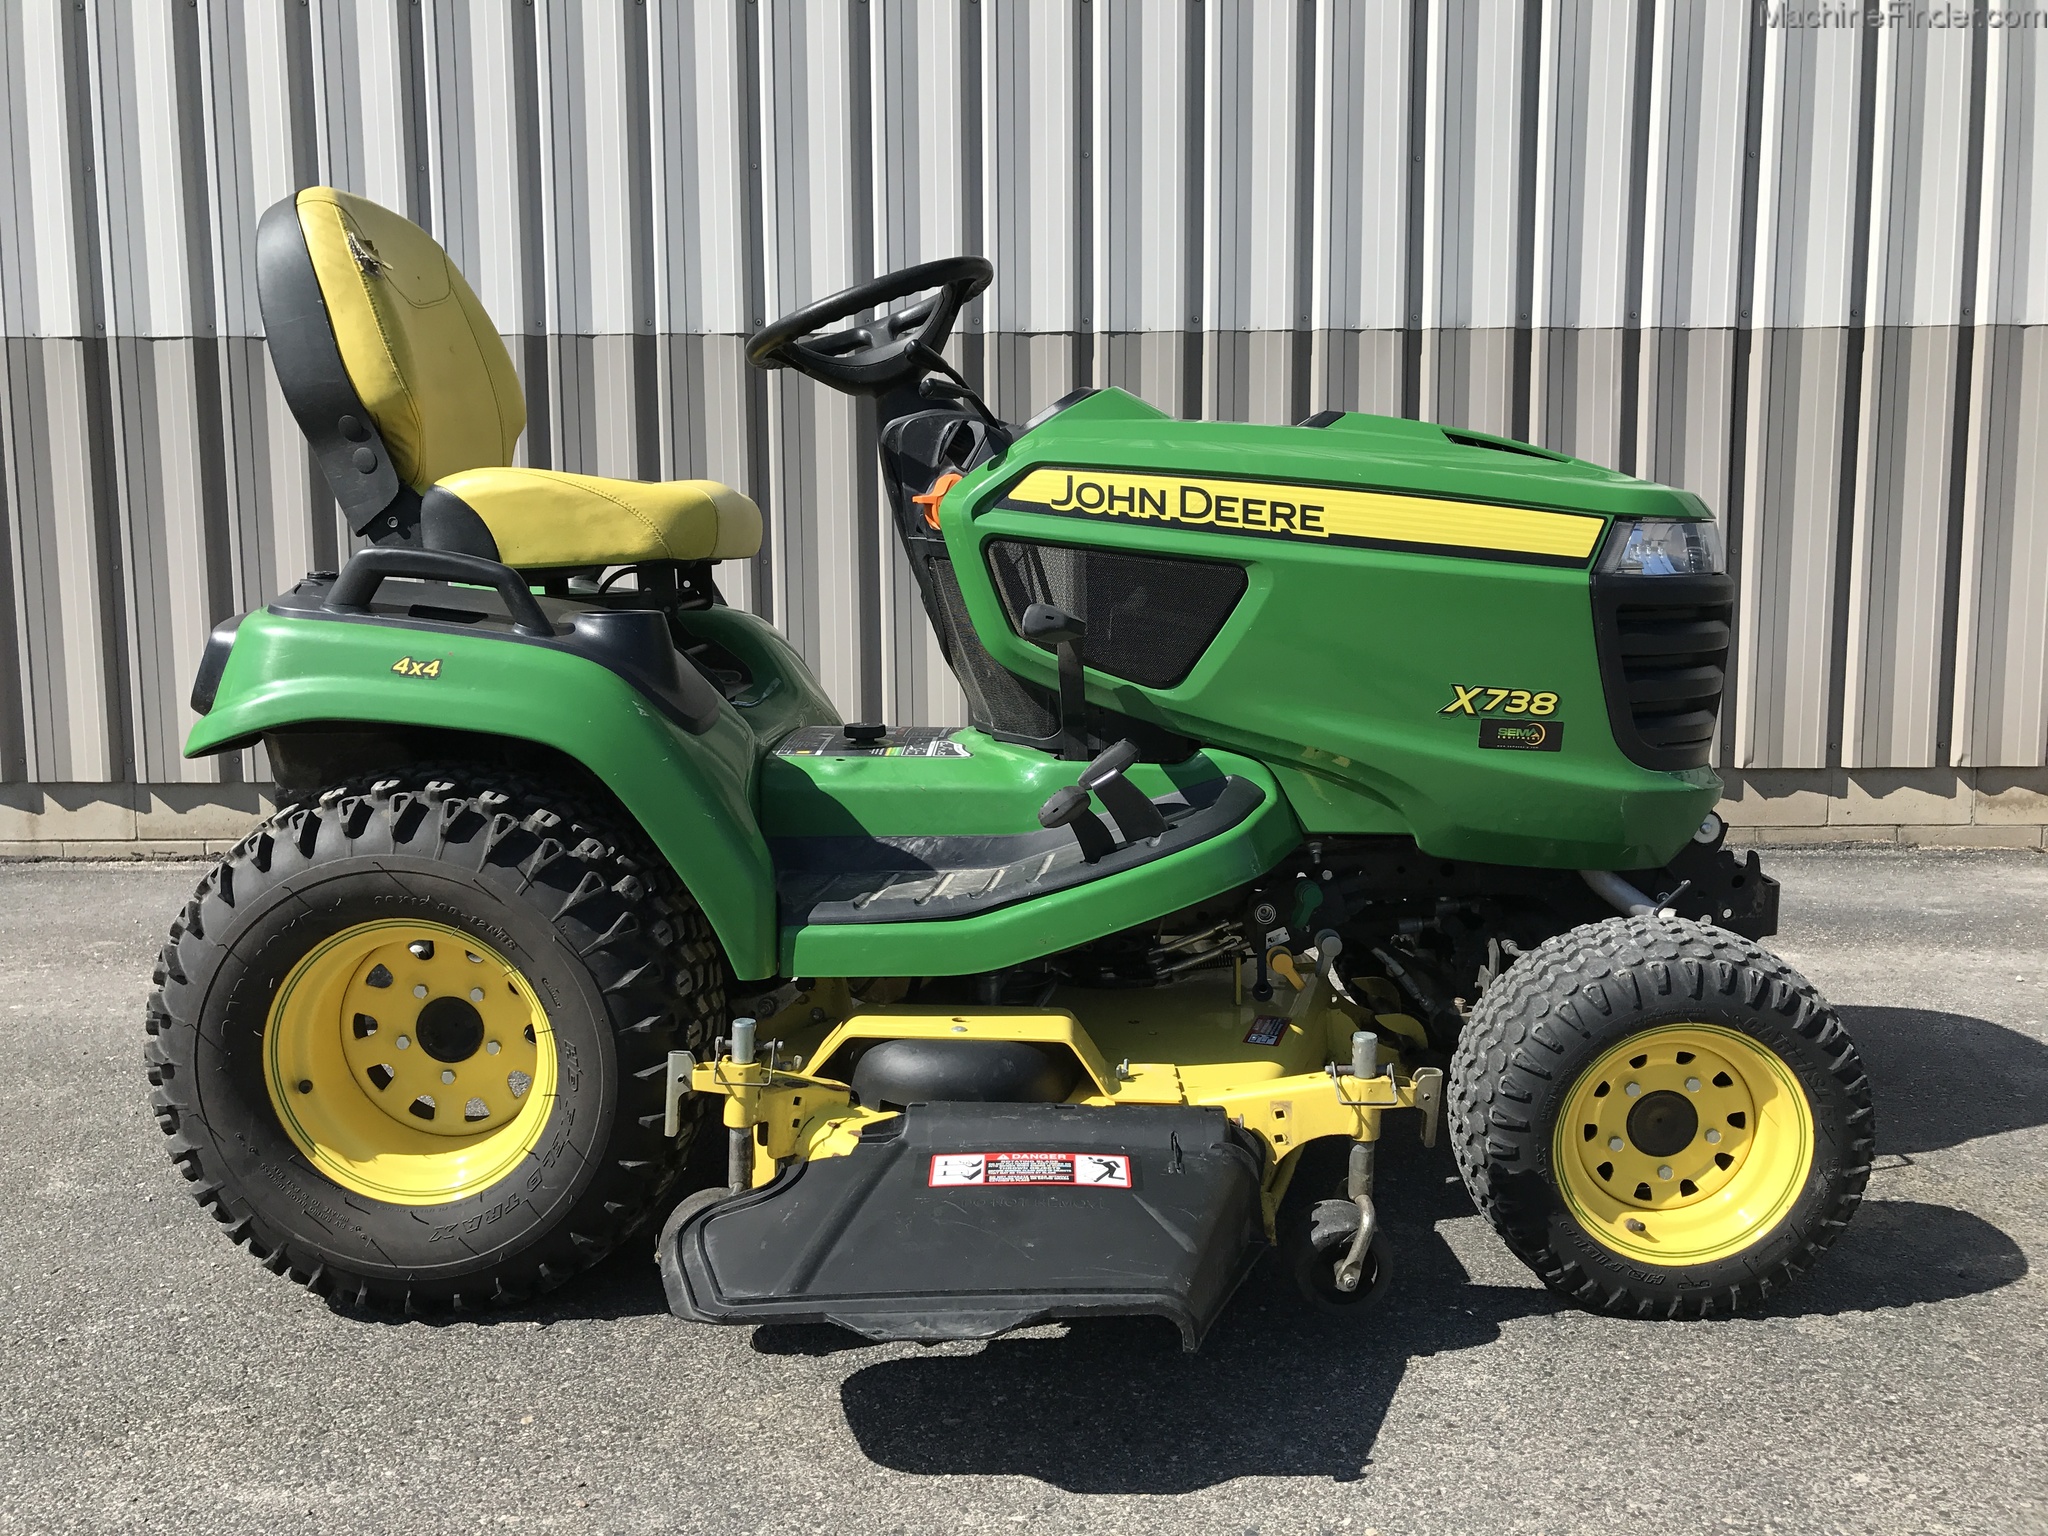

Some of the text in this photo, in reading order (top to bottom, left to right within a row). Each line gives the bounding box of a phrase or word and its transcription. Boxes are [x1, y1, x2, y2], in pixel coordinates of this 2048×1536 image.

[1051, 475, 1325, 533] JOHN DEERE
[391, 656, 442, 678] 4x4
[1440, 684, 1559, 717] X738
[1498, 727, 1540, 738] SEMA
[563, 1038, 580, 1093] HD
[429, 1192, 526, 1243] TRAX
